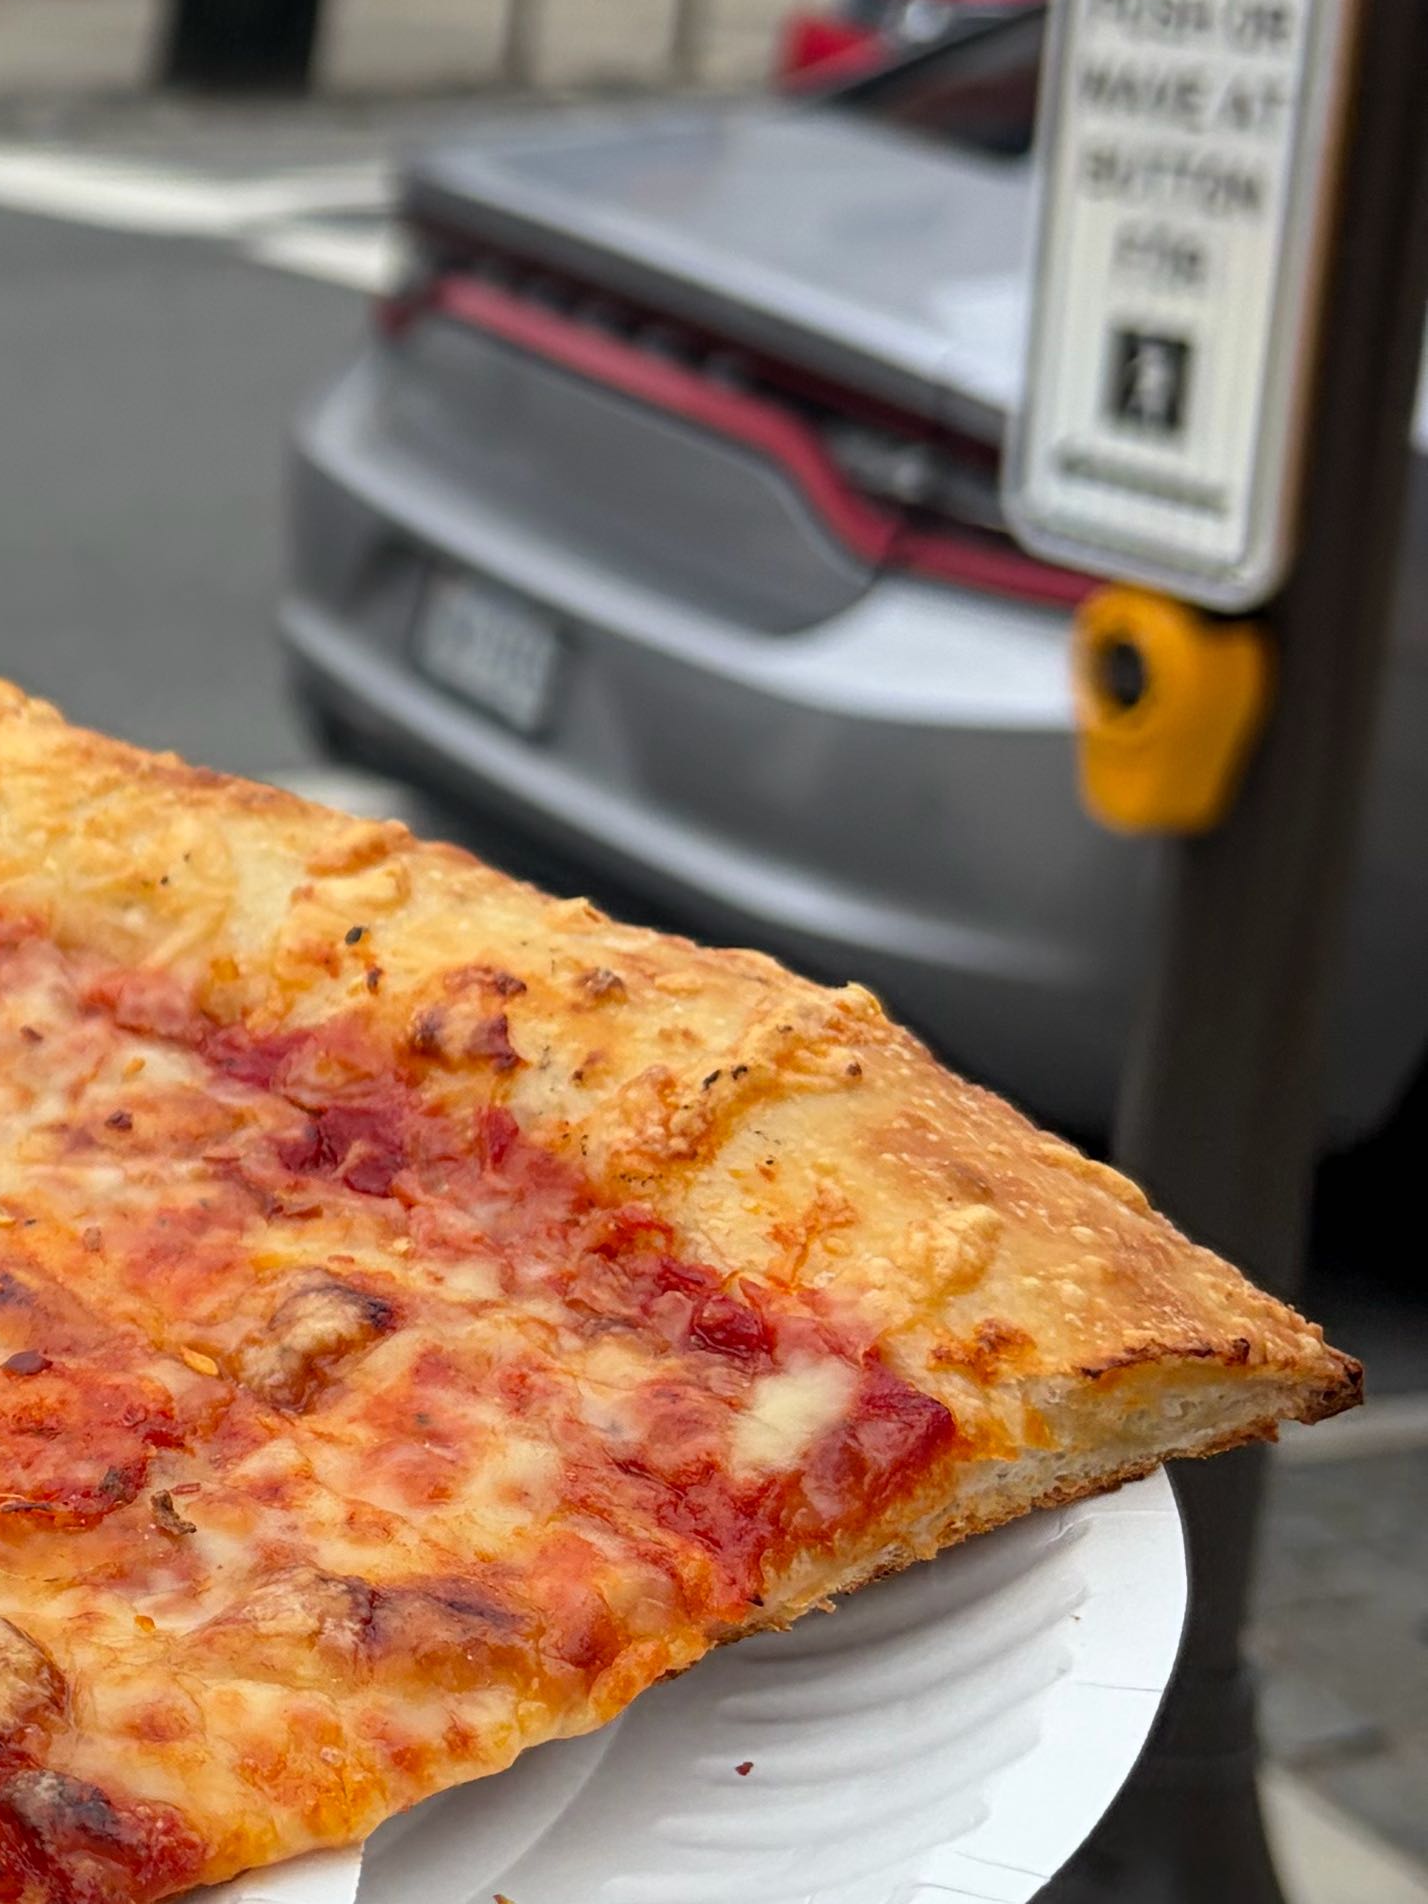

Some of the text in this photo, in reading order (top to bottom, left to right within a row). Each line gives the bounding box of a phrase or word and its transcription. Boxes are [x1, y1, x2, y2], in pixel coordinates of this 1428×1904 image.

[1079, 61, 1292, 134] WAVE AT
[1081, 141, 1266, 218] BUTTON
